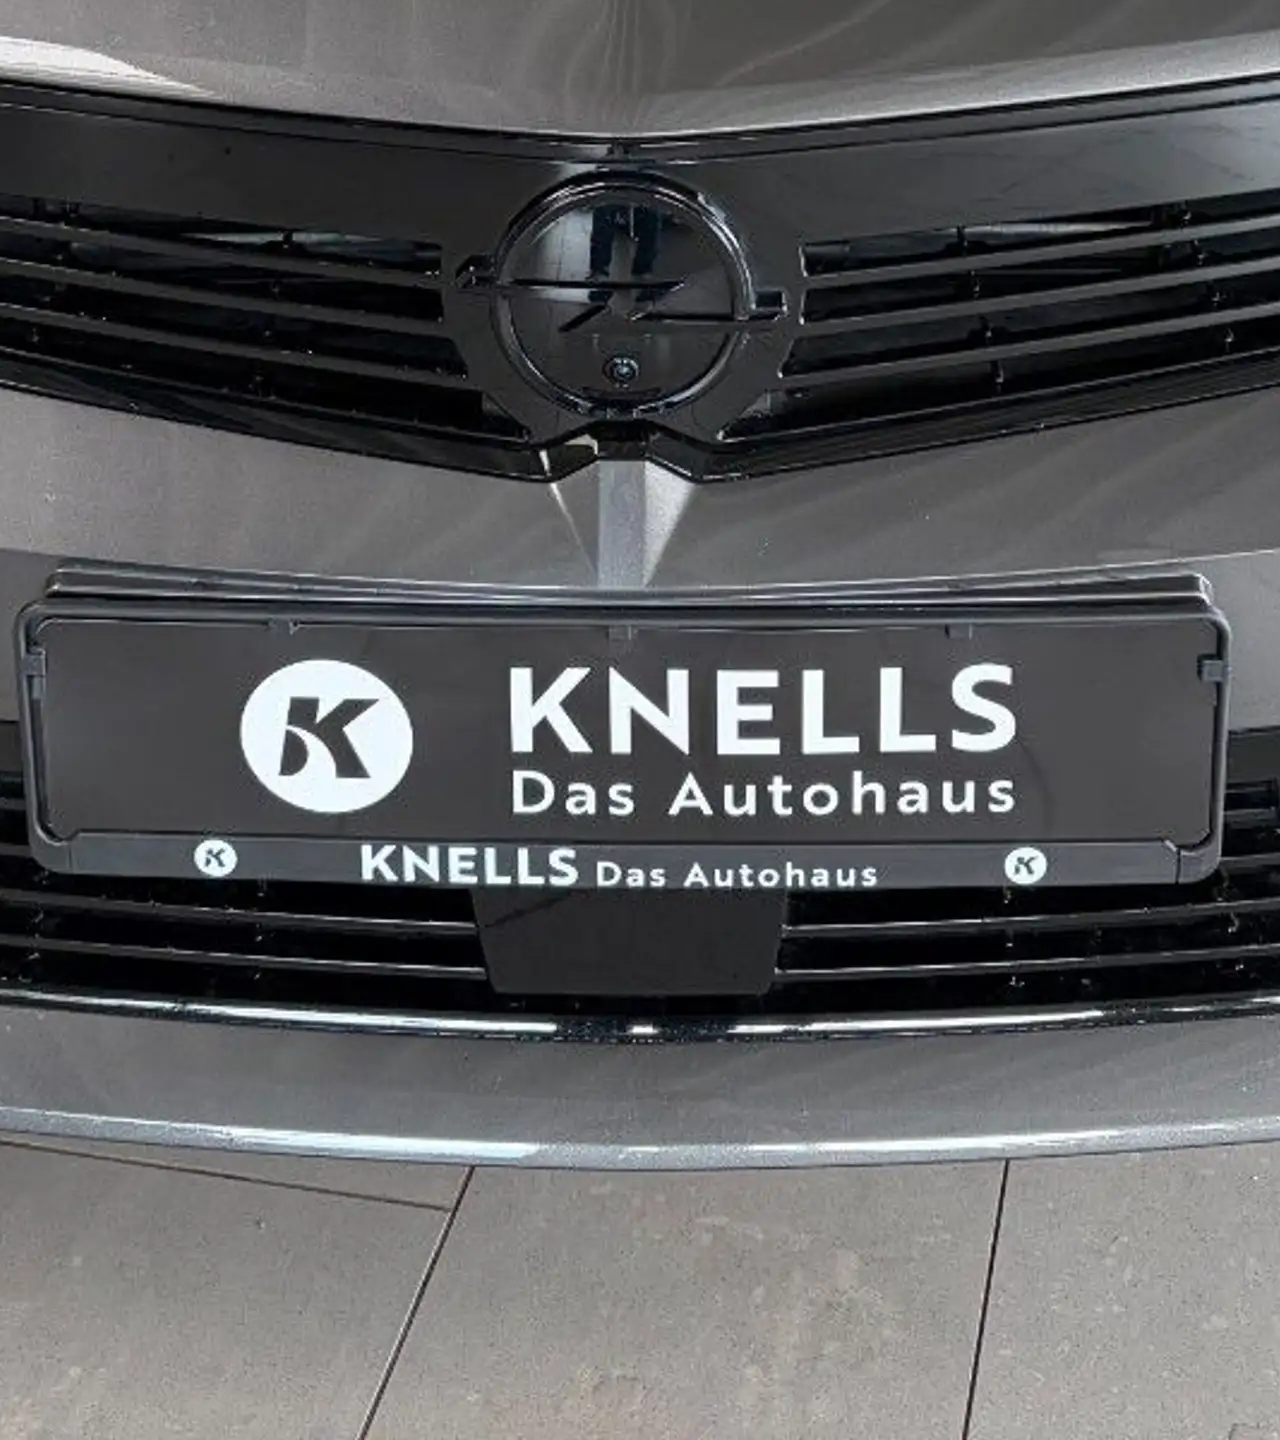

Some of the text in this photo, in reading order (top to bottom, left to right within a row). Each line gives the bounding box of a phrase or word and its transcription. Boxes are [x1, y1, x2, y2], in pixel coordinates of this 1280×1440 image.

[509, 662, 1017, 756] KNELLS
[512, 769, 1016, 817] Das Autohaus
[360, 843, 878, 888] KNELLS Das Autohaus
